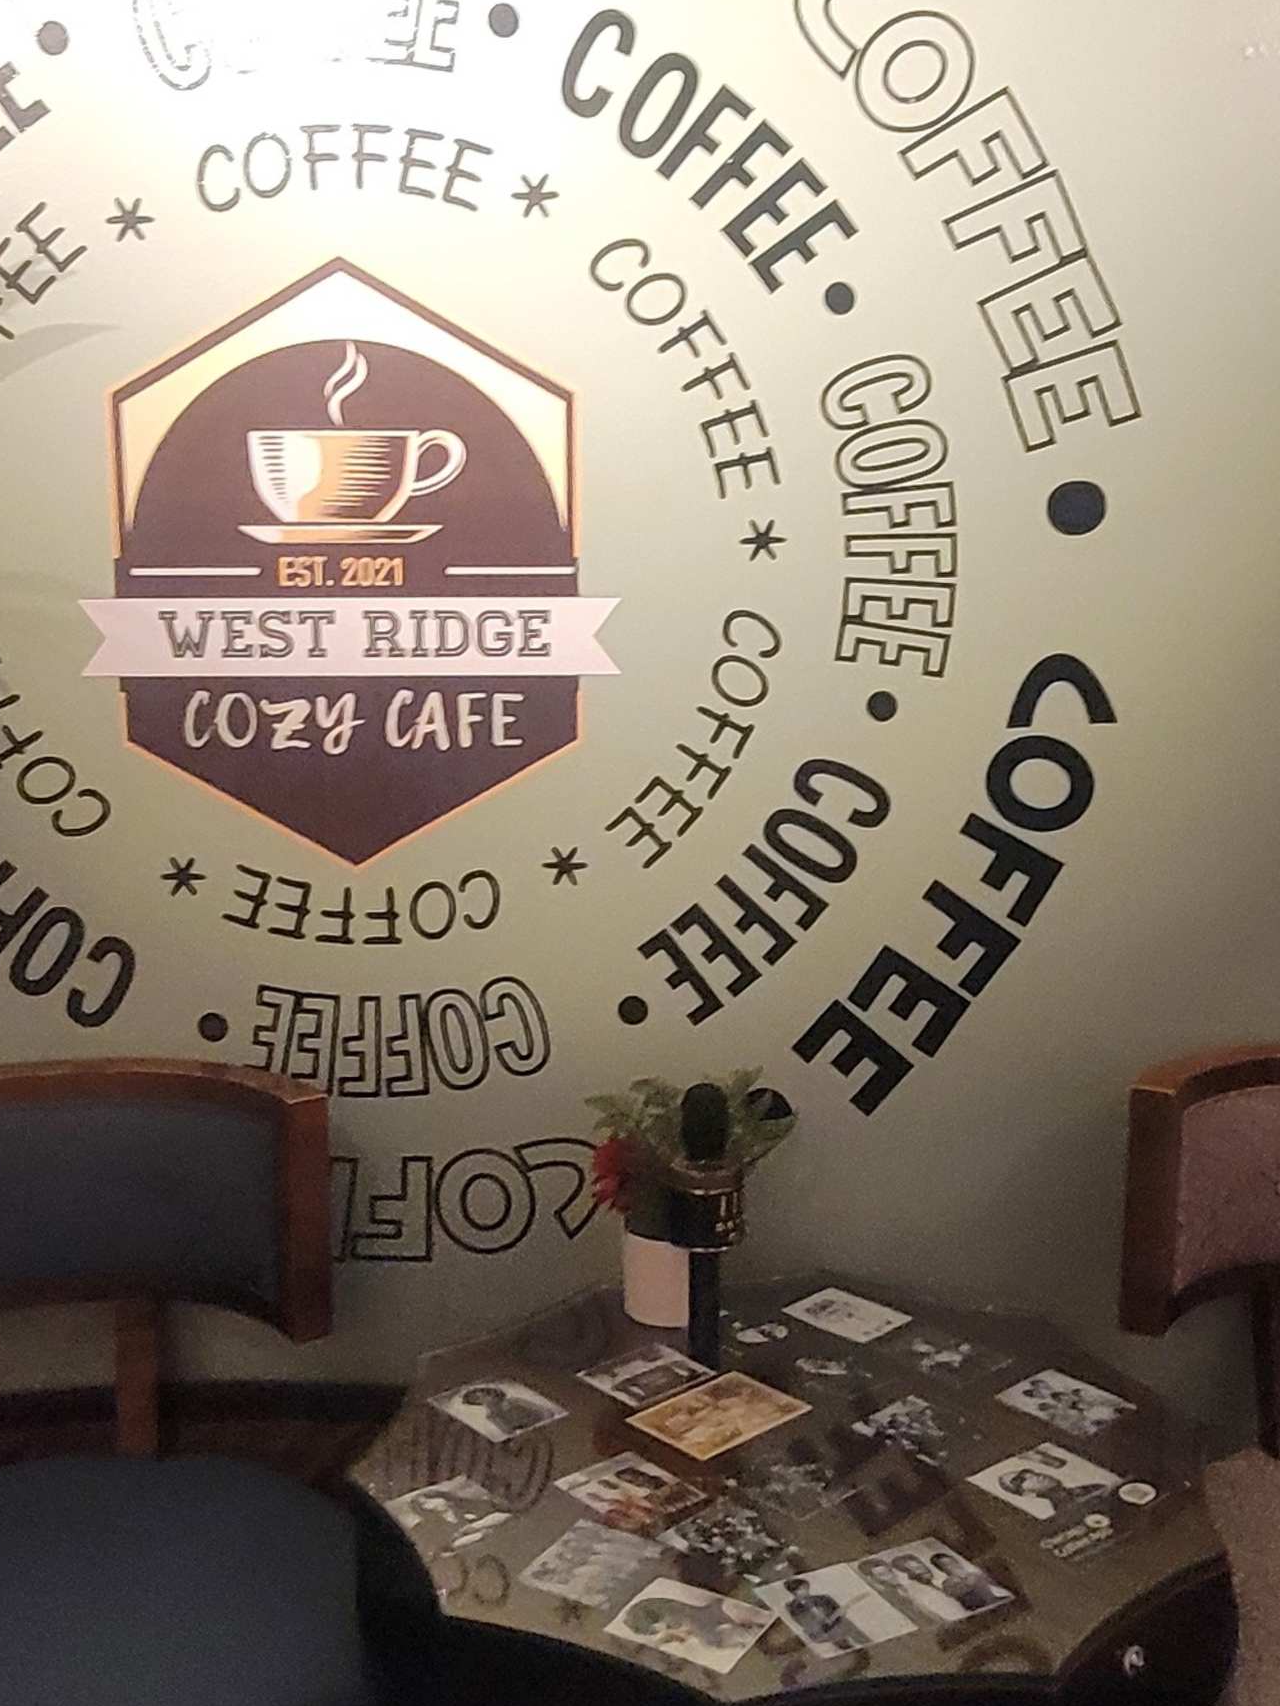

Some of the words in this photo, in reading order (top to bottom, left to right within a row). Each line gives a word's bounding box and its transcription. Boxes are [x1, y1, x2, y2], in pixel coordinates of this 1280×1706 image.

[196, 124, 494, 213] COFFEE
[561, 8, 859, 294] COFFEE
[589, 238, 780, 499] COFFEE
[278, 556, 335, 588] EST.
[340, 556, 404, 587] 2021
[820, 353, 958, 678] COFFEE
[158, 610, 337, 658] WEST
[363, 610, 553, 658] RIDGE
[384, 689, 524, 751] CAFE
[605, 609, 782, 869] COFFEE
[221, 863, 501, 945] COFFEE
[637, 758, 892, 1026] COFFEE
[791, 653, 1118, 1117] COFFEE
[245, 975, 551, 1098] COFFEE
